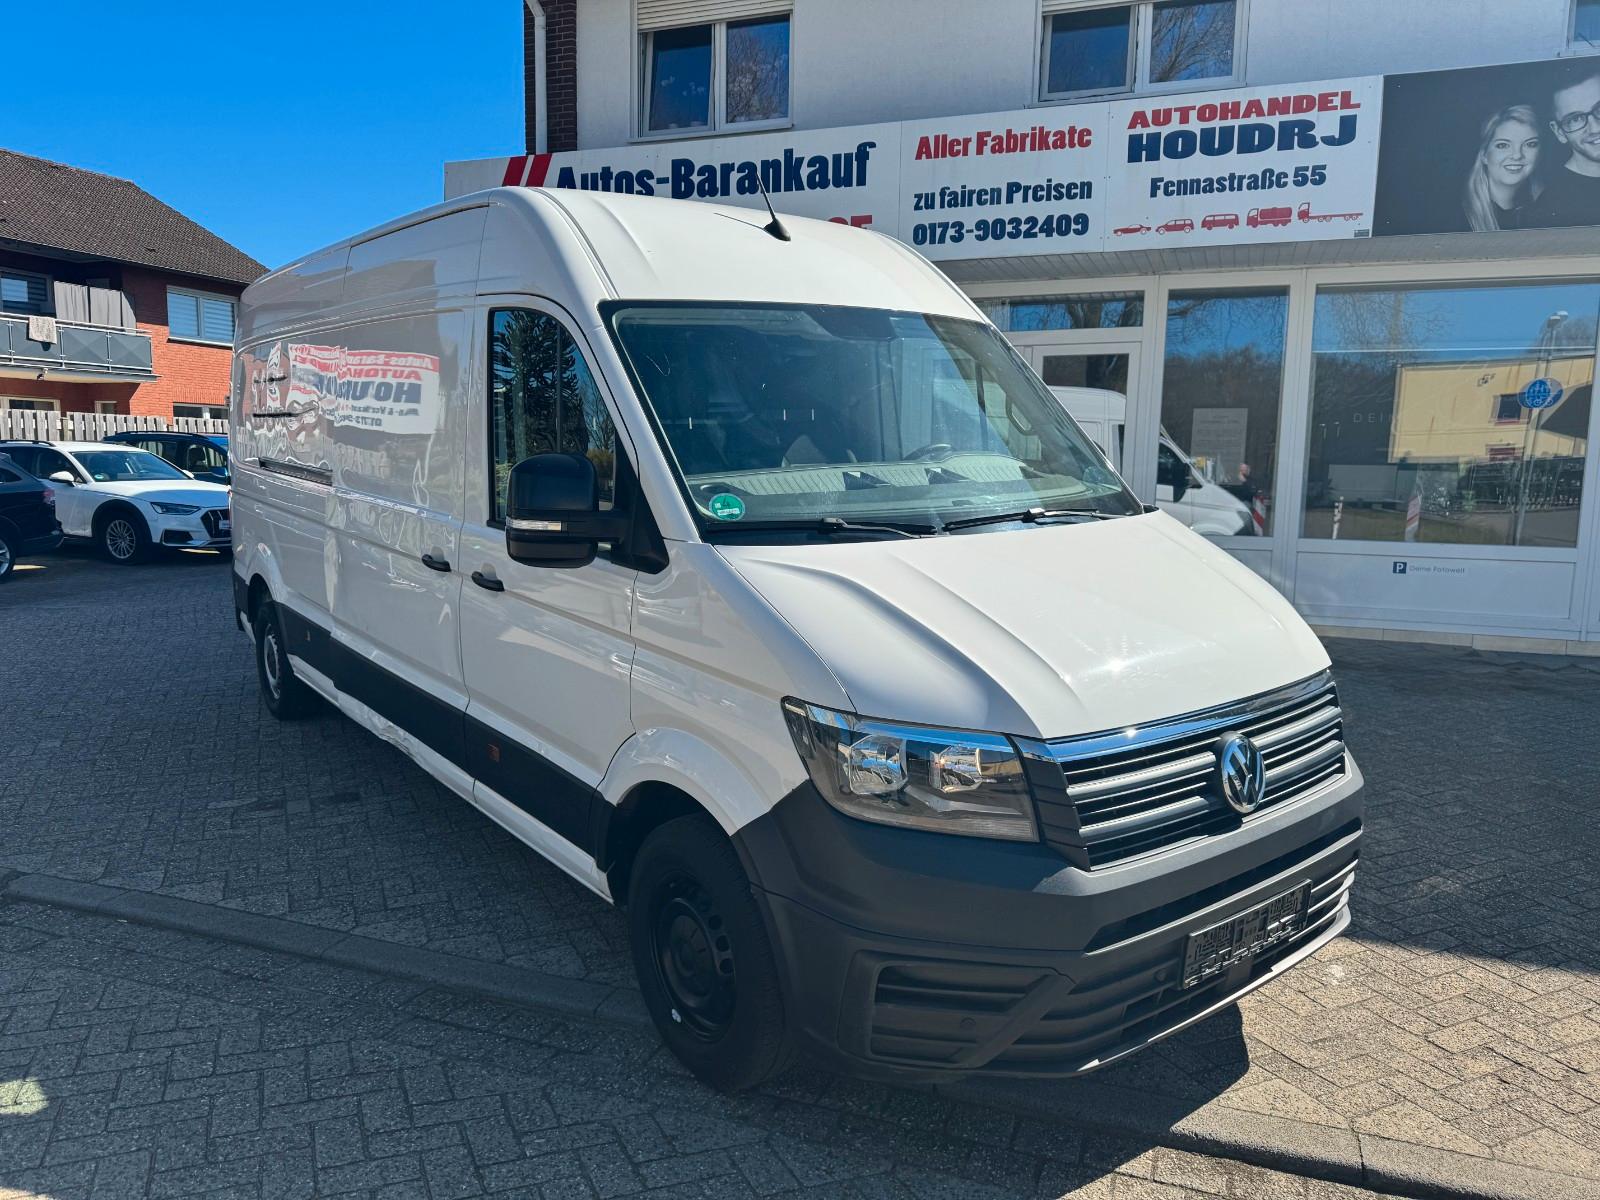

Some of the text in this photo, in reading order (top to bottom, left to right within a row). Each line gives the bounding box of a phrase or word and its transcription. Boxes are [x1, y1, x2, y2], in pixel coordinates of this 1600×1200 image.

[1127, 91, 1360, 130] AUTOHANDEL
[914, 125, 1092, 160] Aller Fabrikate
[1127, 113, 1357, 163] HOUDRJ
[555, 141, 876, 200] Autos-Barankauf
[1150, 164, 1327, 198] Fennastraße 55
[913, 178, 1092, 211] zu fairen Preisen
[912, 213, 1089, 246] 0173-9032409
